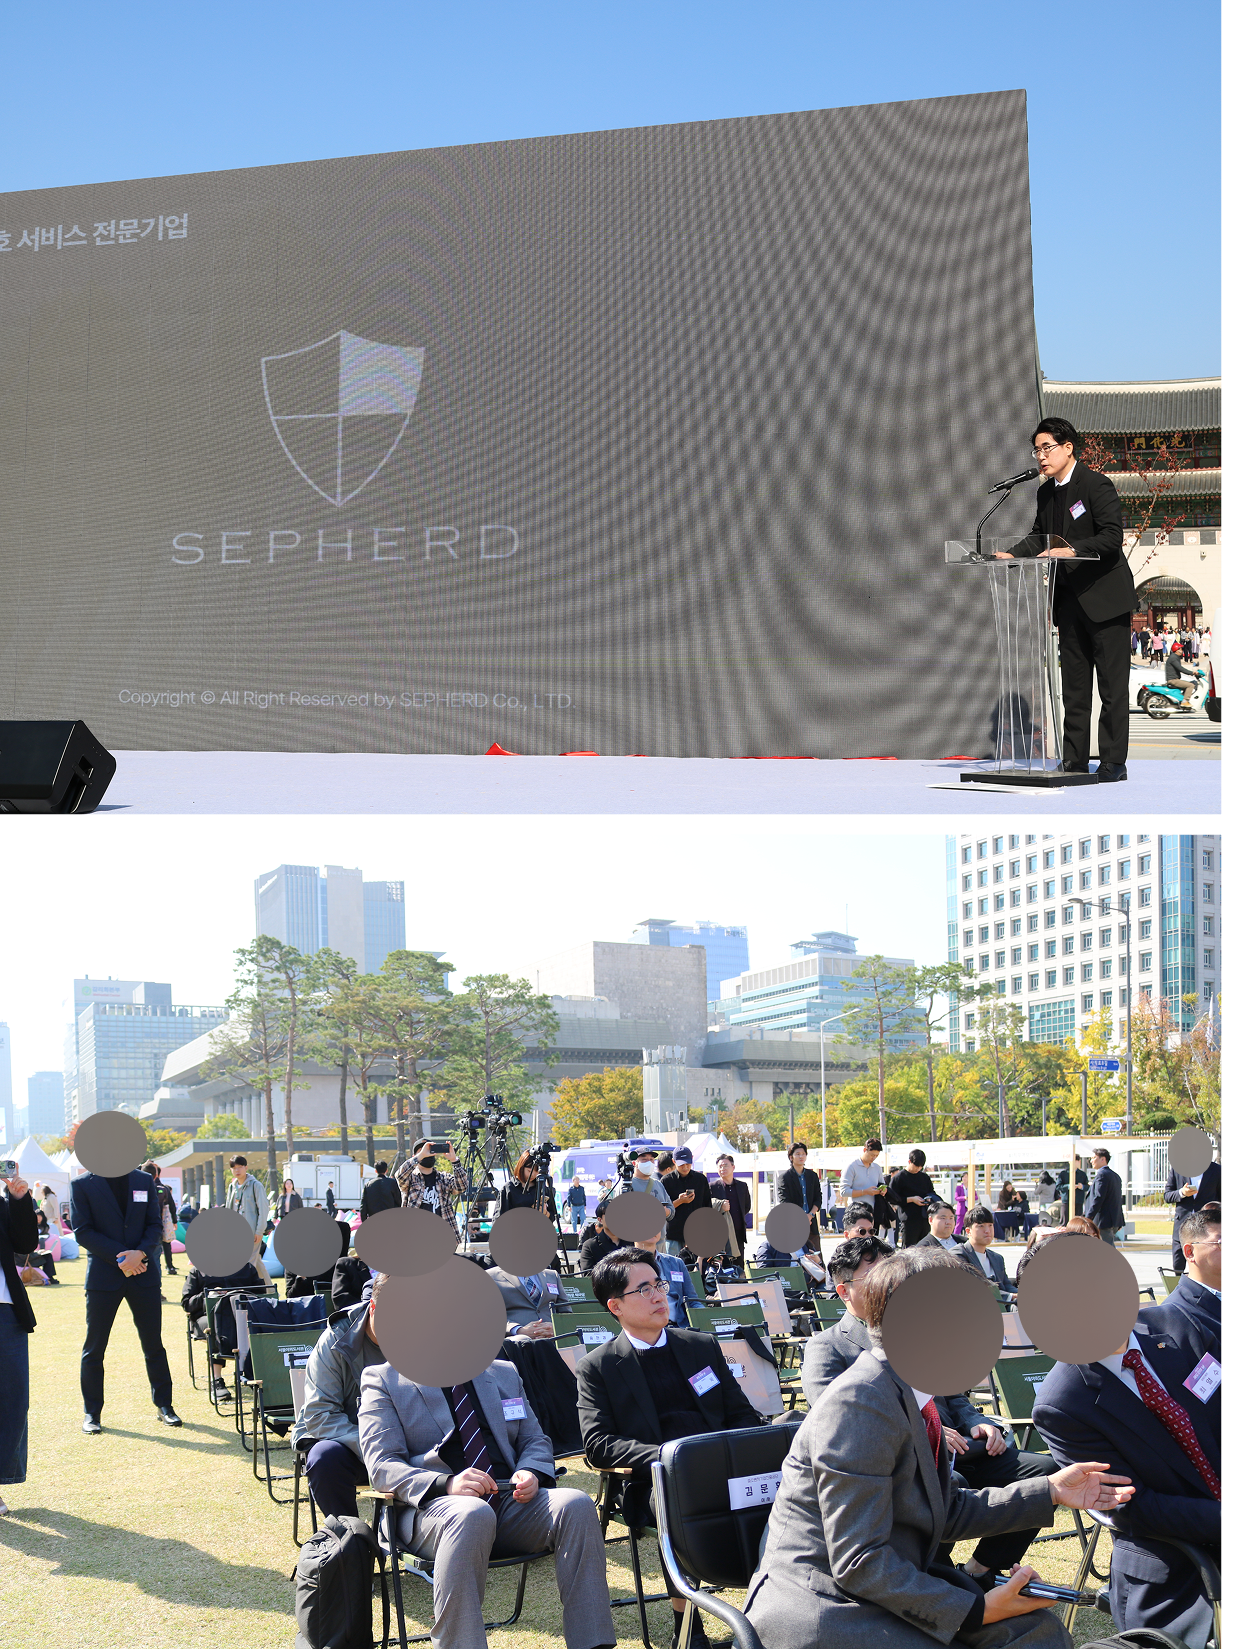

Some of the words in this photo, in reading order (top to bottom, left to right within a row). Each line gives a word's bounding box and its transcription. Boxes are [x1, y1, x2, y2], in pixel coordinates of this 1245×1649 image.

[17, 224, 87, 251] 서비스
[93, 213, 188, 246] 전문기업
[171, 525, 520, 565] SEPHERD
[119, 689, 196, 708] Copyright
[220, 690, 239, 705] All
[244, 690, 286, 709] Right
[290, 691, 369, 707] Reserved
[374, 692, 396, 710] by
[400, 692, 488, 708] SEPHERD
[493, 693, 528, 712] Co.,
